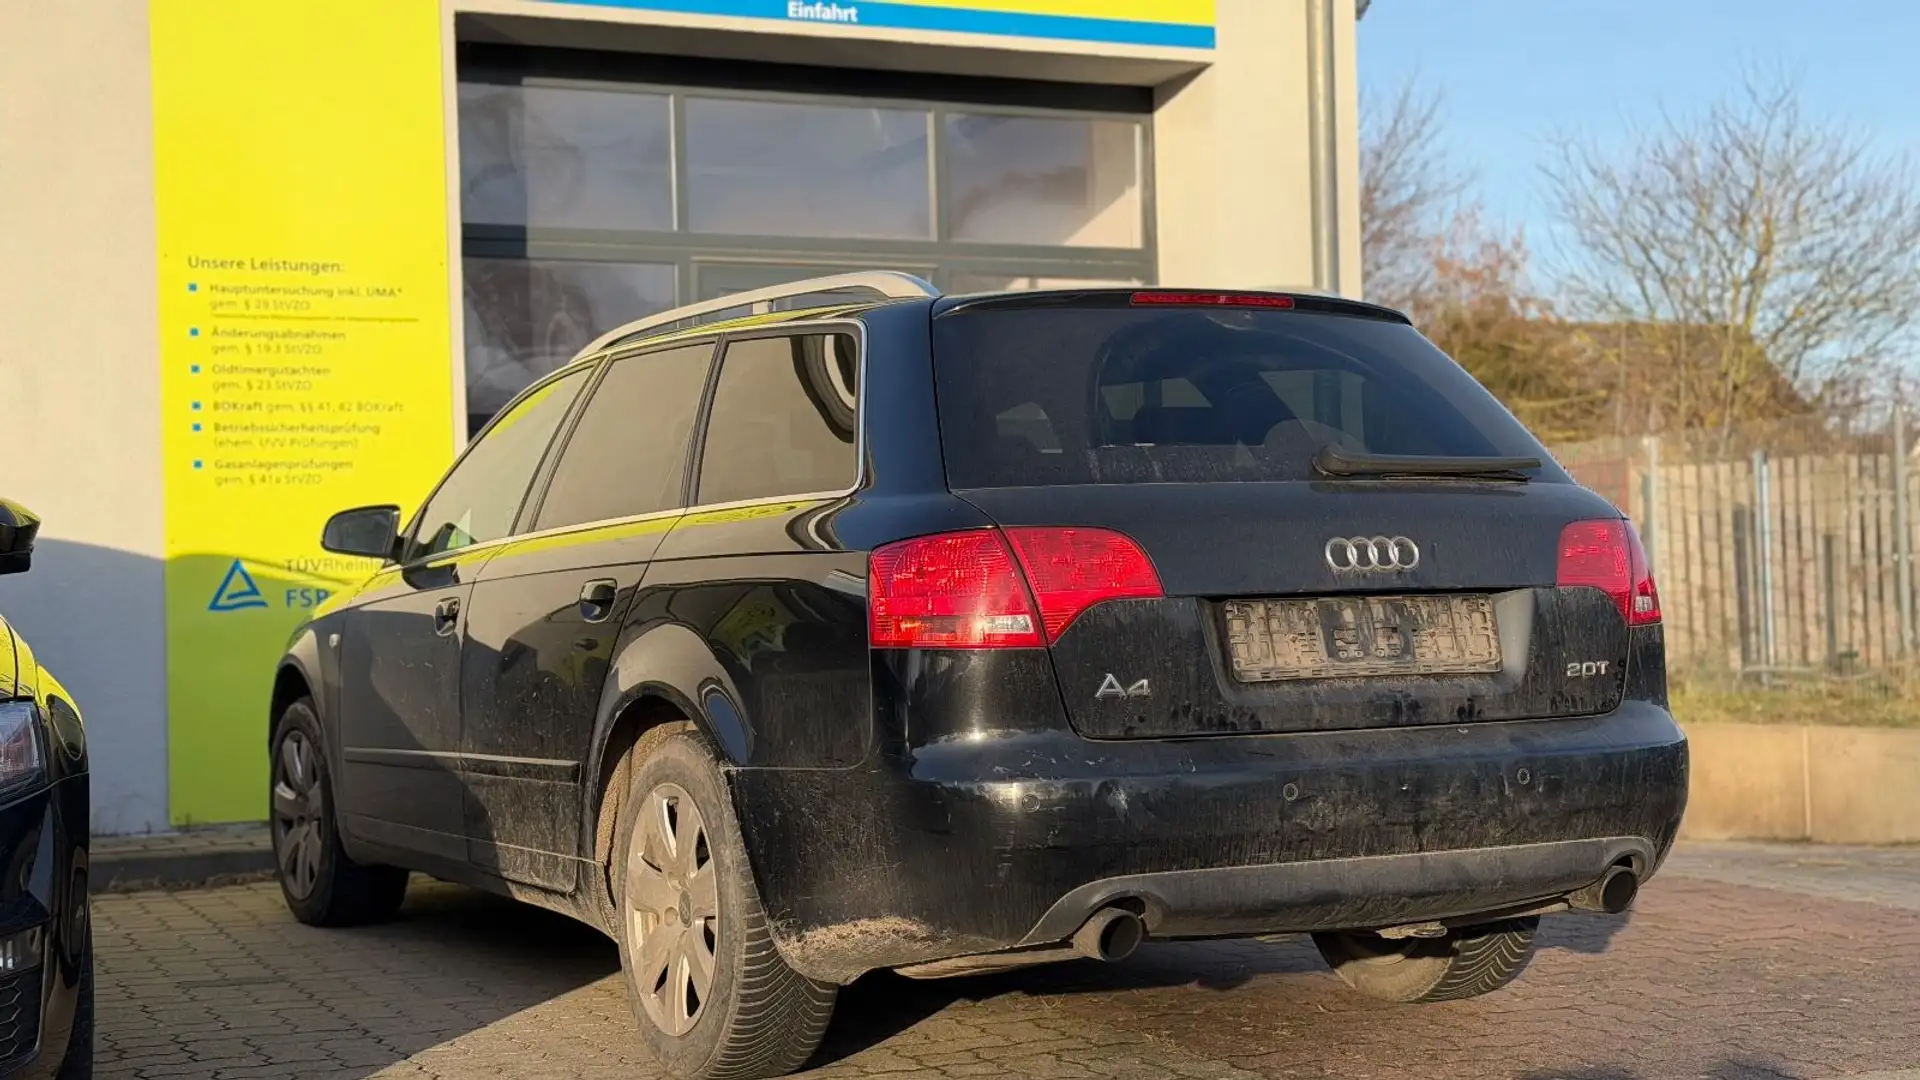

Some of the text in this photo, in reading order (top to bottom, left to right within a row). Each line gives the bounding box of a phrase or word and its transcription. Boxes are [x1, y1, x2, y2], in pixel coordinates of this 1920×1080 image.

[787, 1, 858, 23] Einfahrt
[187, 256, 345, 276] Unsere Leistungen:
[209, 284, 334, 298] Hauptuntersuchung
[337, 285, 361, 296] inkl.
[244, 299, 251, 311] §
[273, 299, 311, 311] StVZO
[211, 325, 346, 340] Änderungsabnahmen
[211, 344, 240, 355] gem.
[245, 343, 252, 355] §
[284, 343, 322, 355] StVZO
[211, 364, 332, 378] Oldtimergutachten
[212, 380, 241, 392] gem.
[246, 379, 253, 392] §
[275, 380, 312, 391] StVZO
[213, 400, 262, 411] BOKraft
[357, 401, 404, 412] BOKraft
[213, 421, 381, 435] Betriebssicherheitsprüfung
[214, 458, 354, 471] Gasanlagenprüfungen
[1095, 673, 1150, 700] A4
